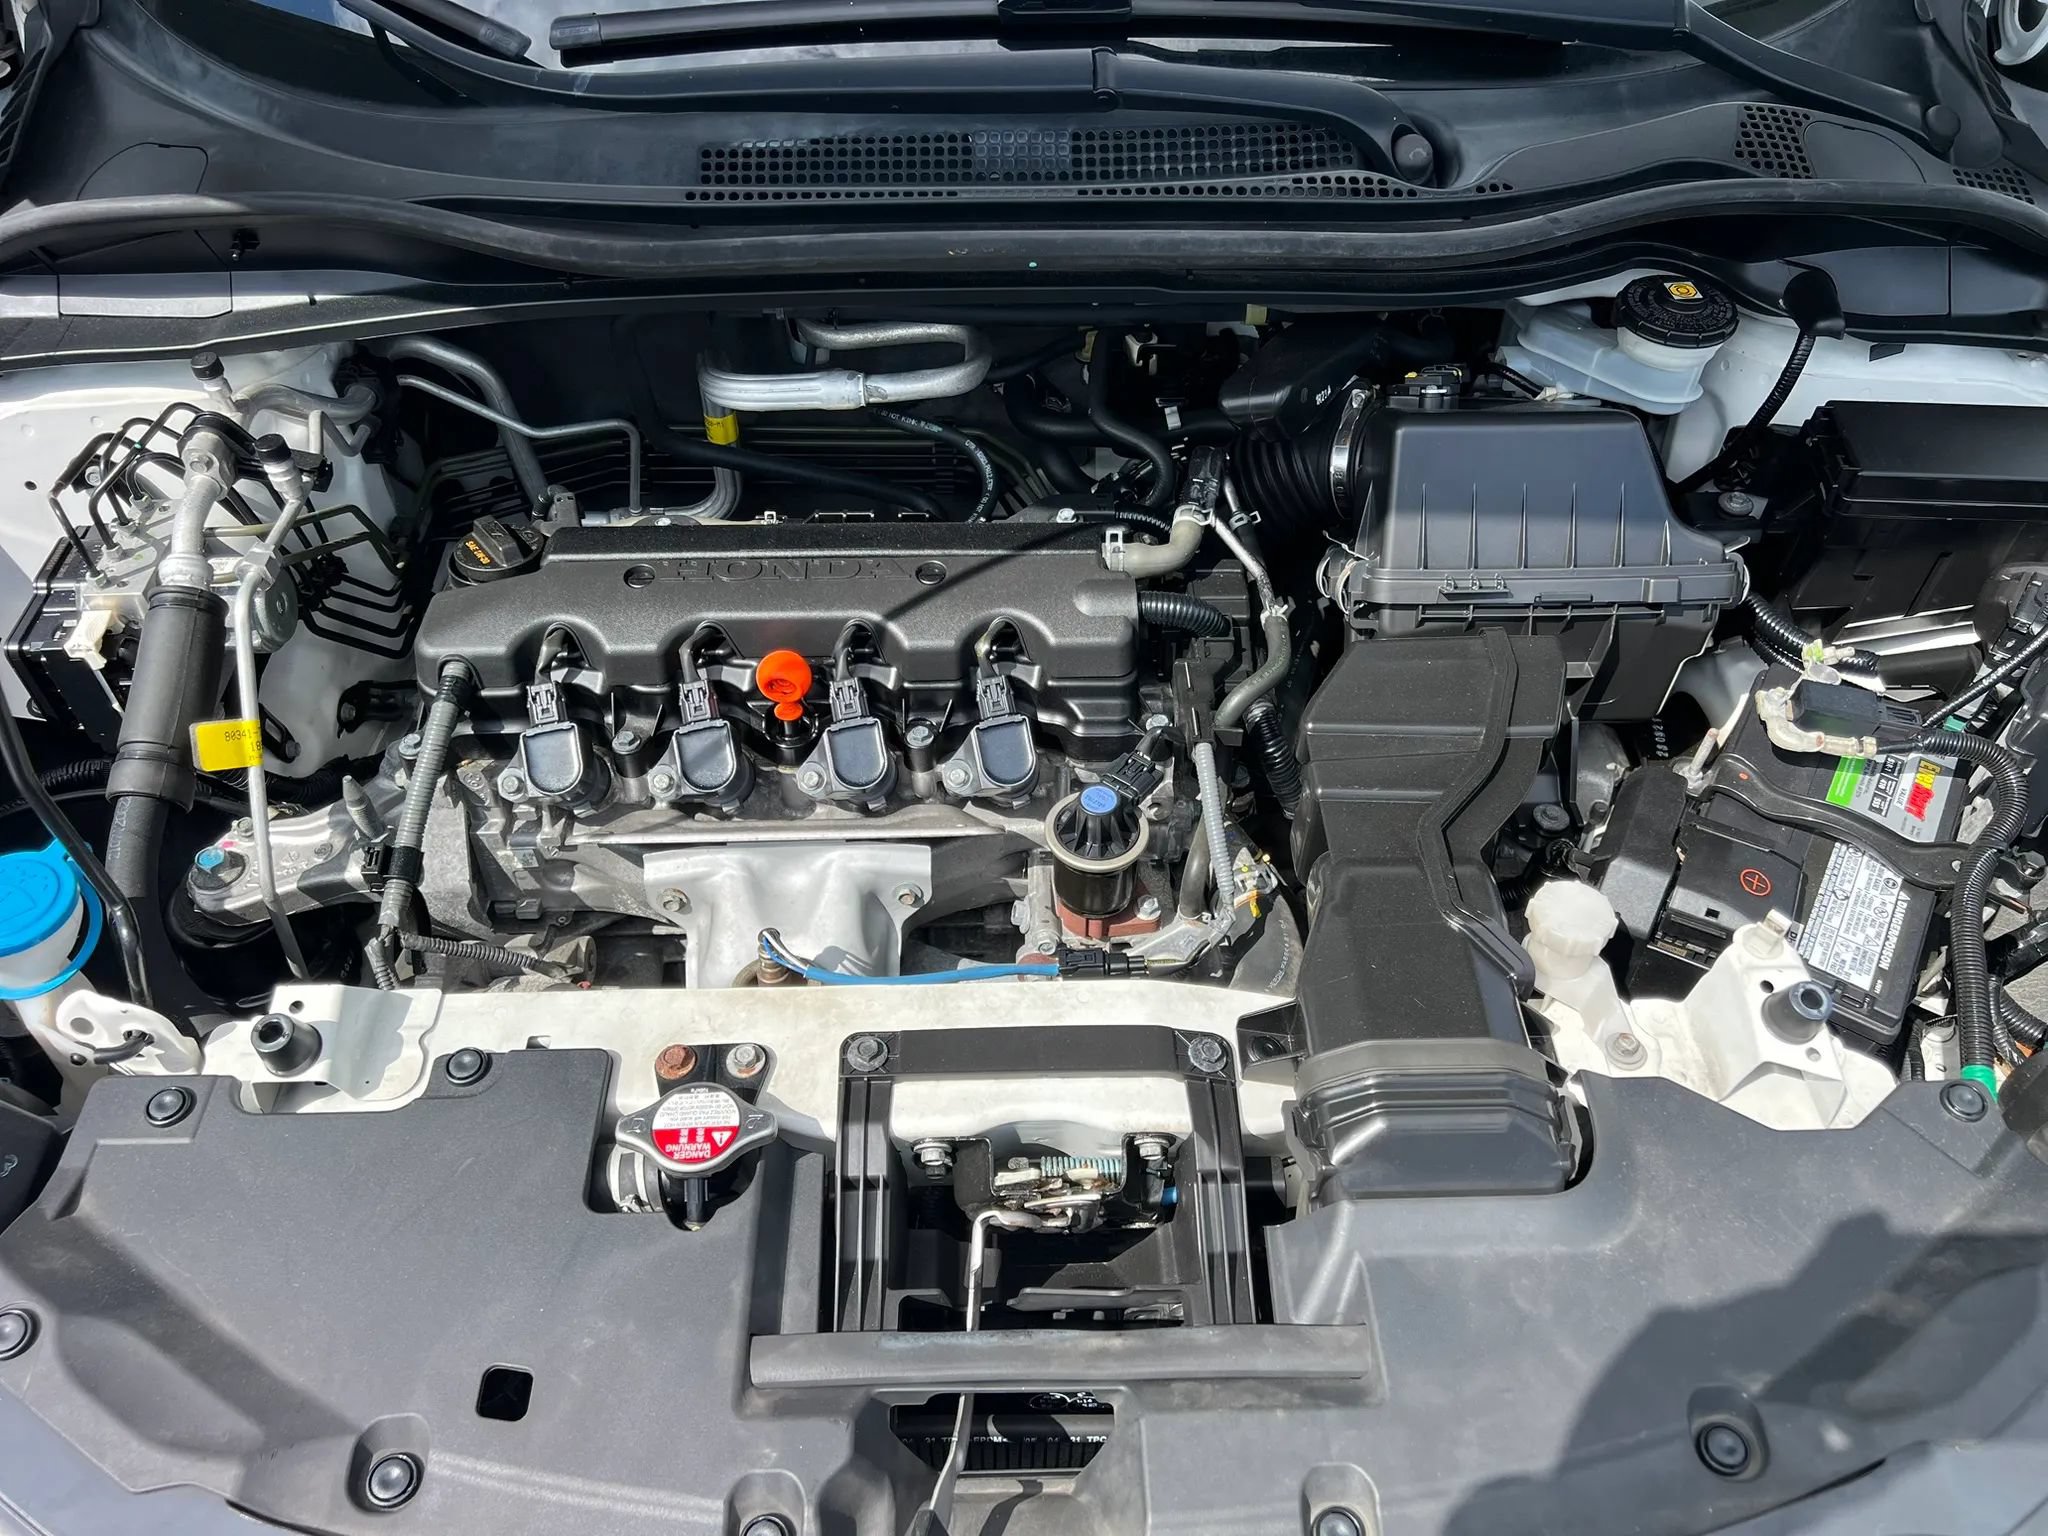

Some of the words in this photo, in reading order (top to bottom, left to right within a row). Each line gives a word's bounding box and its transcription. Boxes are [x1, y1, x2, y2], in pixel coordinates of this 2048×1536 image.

[465, 541, 478, 554] SAE
[659, 558, 912, 582] HONDA
[1877, 899, 1909, 970] DANGER/POISON
[665, 1142, 711, 1152] WARNUNG
[674, 1150, 711, 1158] DANGER
